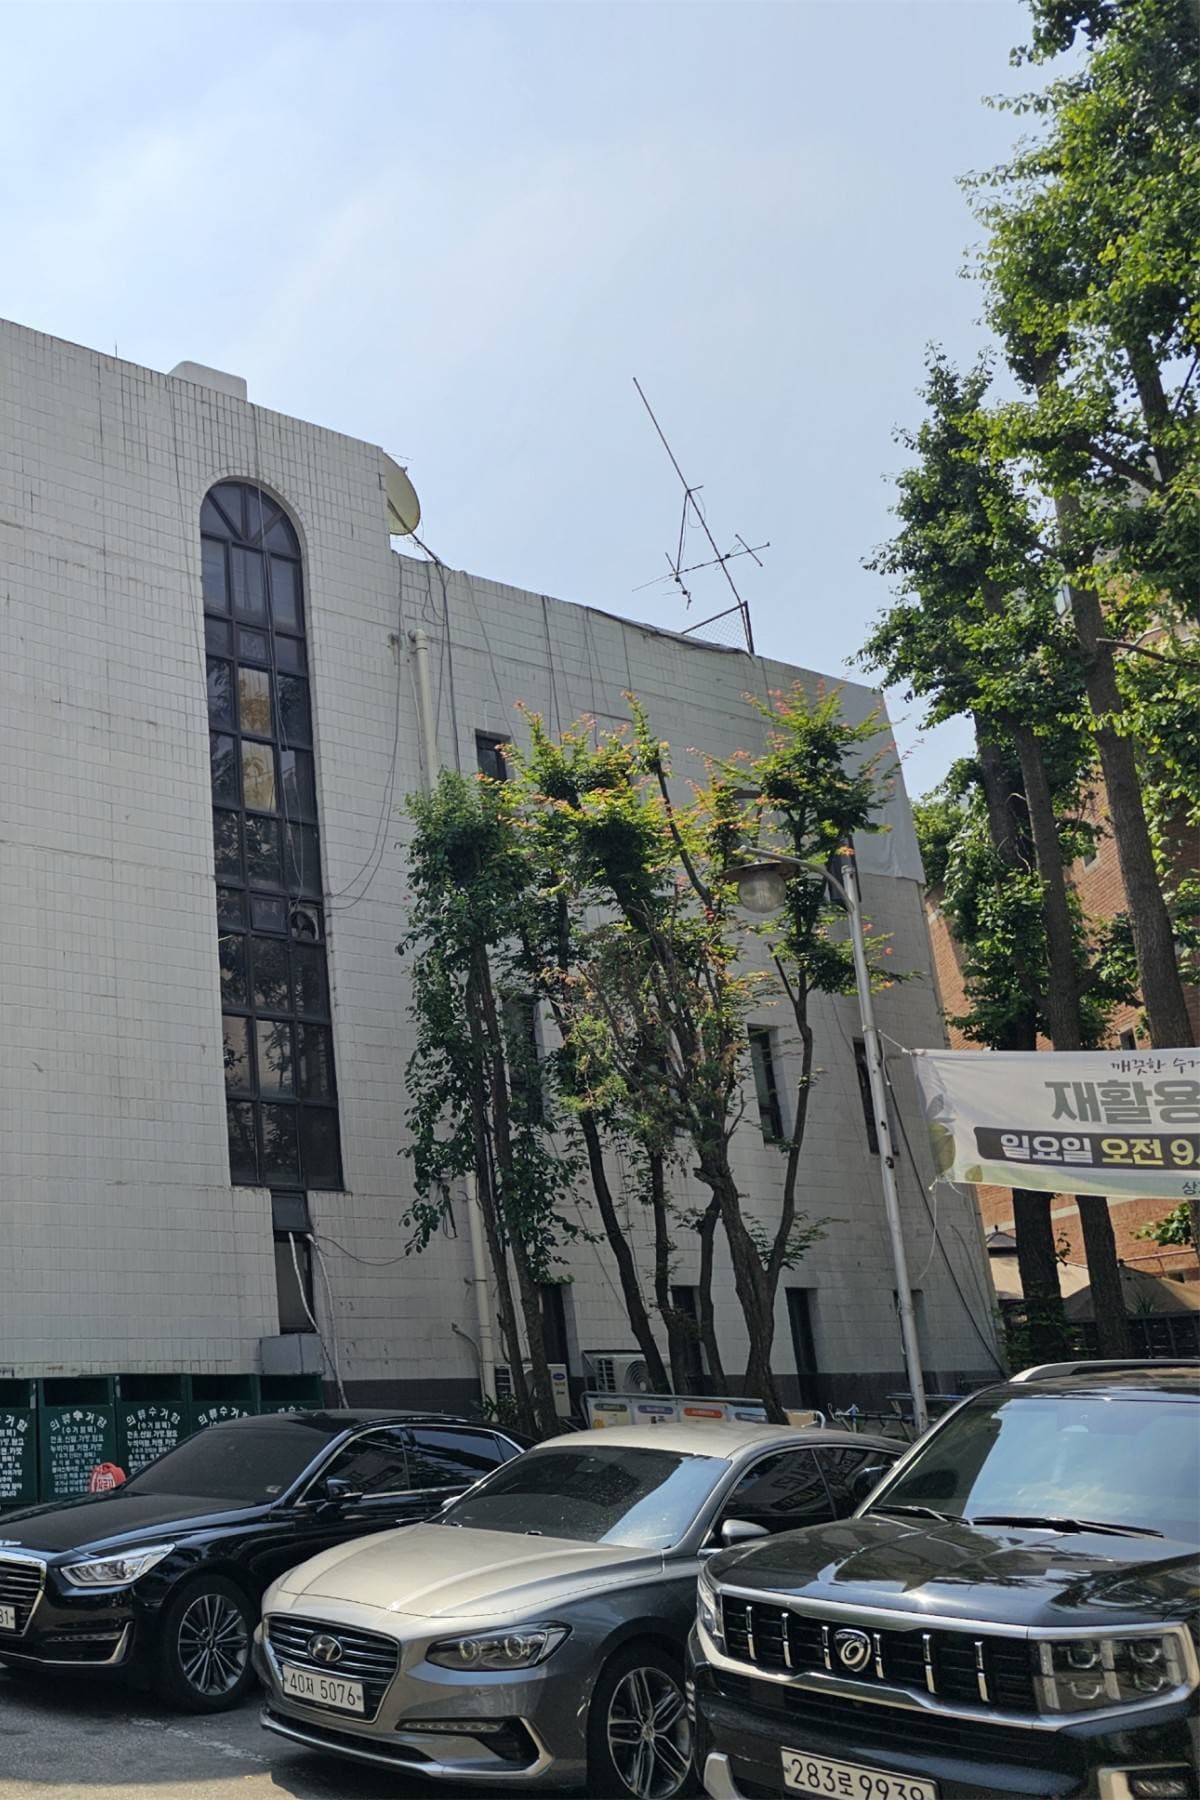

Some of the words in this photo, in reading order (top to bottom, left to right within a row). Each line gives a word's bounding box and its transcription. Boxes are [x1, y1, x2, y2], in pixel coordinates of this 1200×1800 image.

[1111, 1058, 1166, 1075] 깨끗한
[1045, 1079, 1200, 1125] 재활용
[1001, 1133, 1093, 1164] 일요일
[1101, 1138, 1164, 1166] 오전
[1170, 1139, 1200, 1166] 9
[1182, 1182, 1200, 1195] 상
[320, 1680, 356, 1706] 5076
[791, 1758, 854, 1797] 283로
